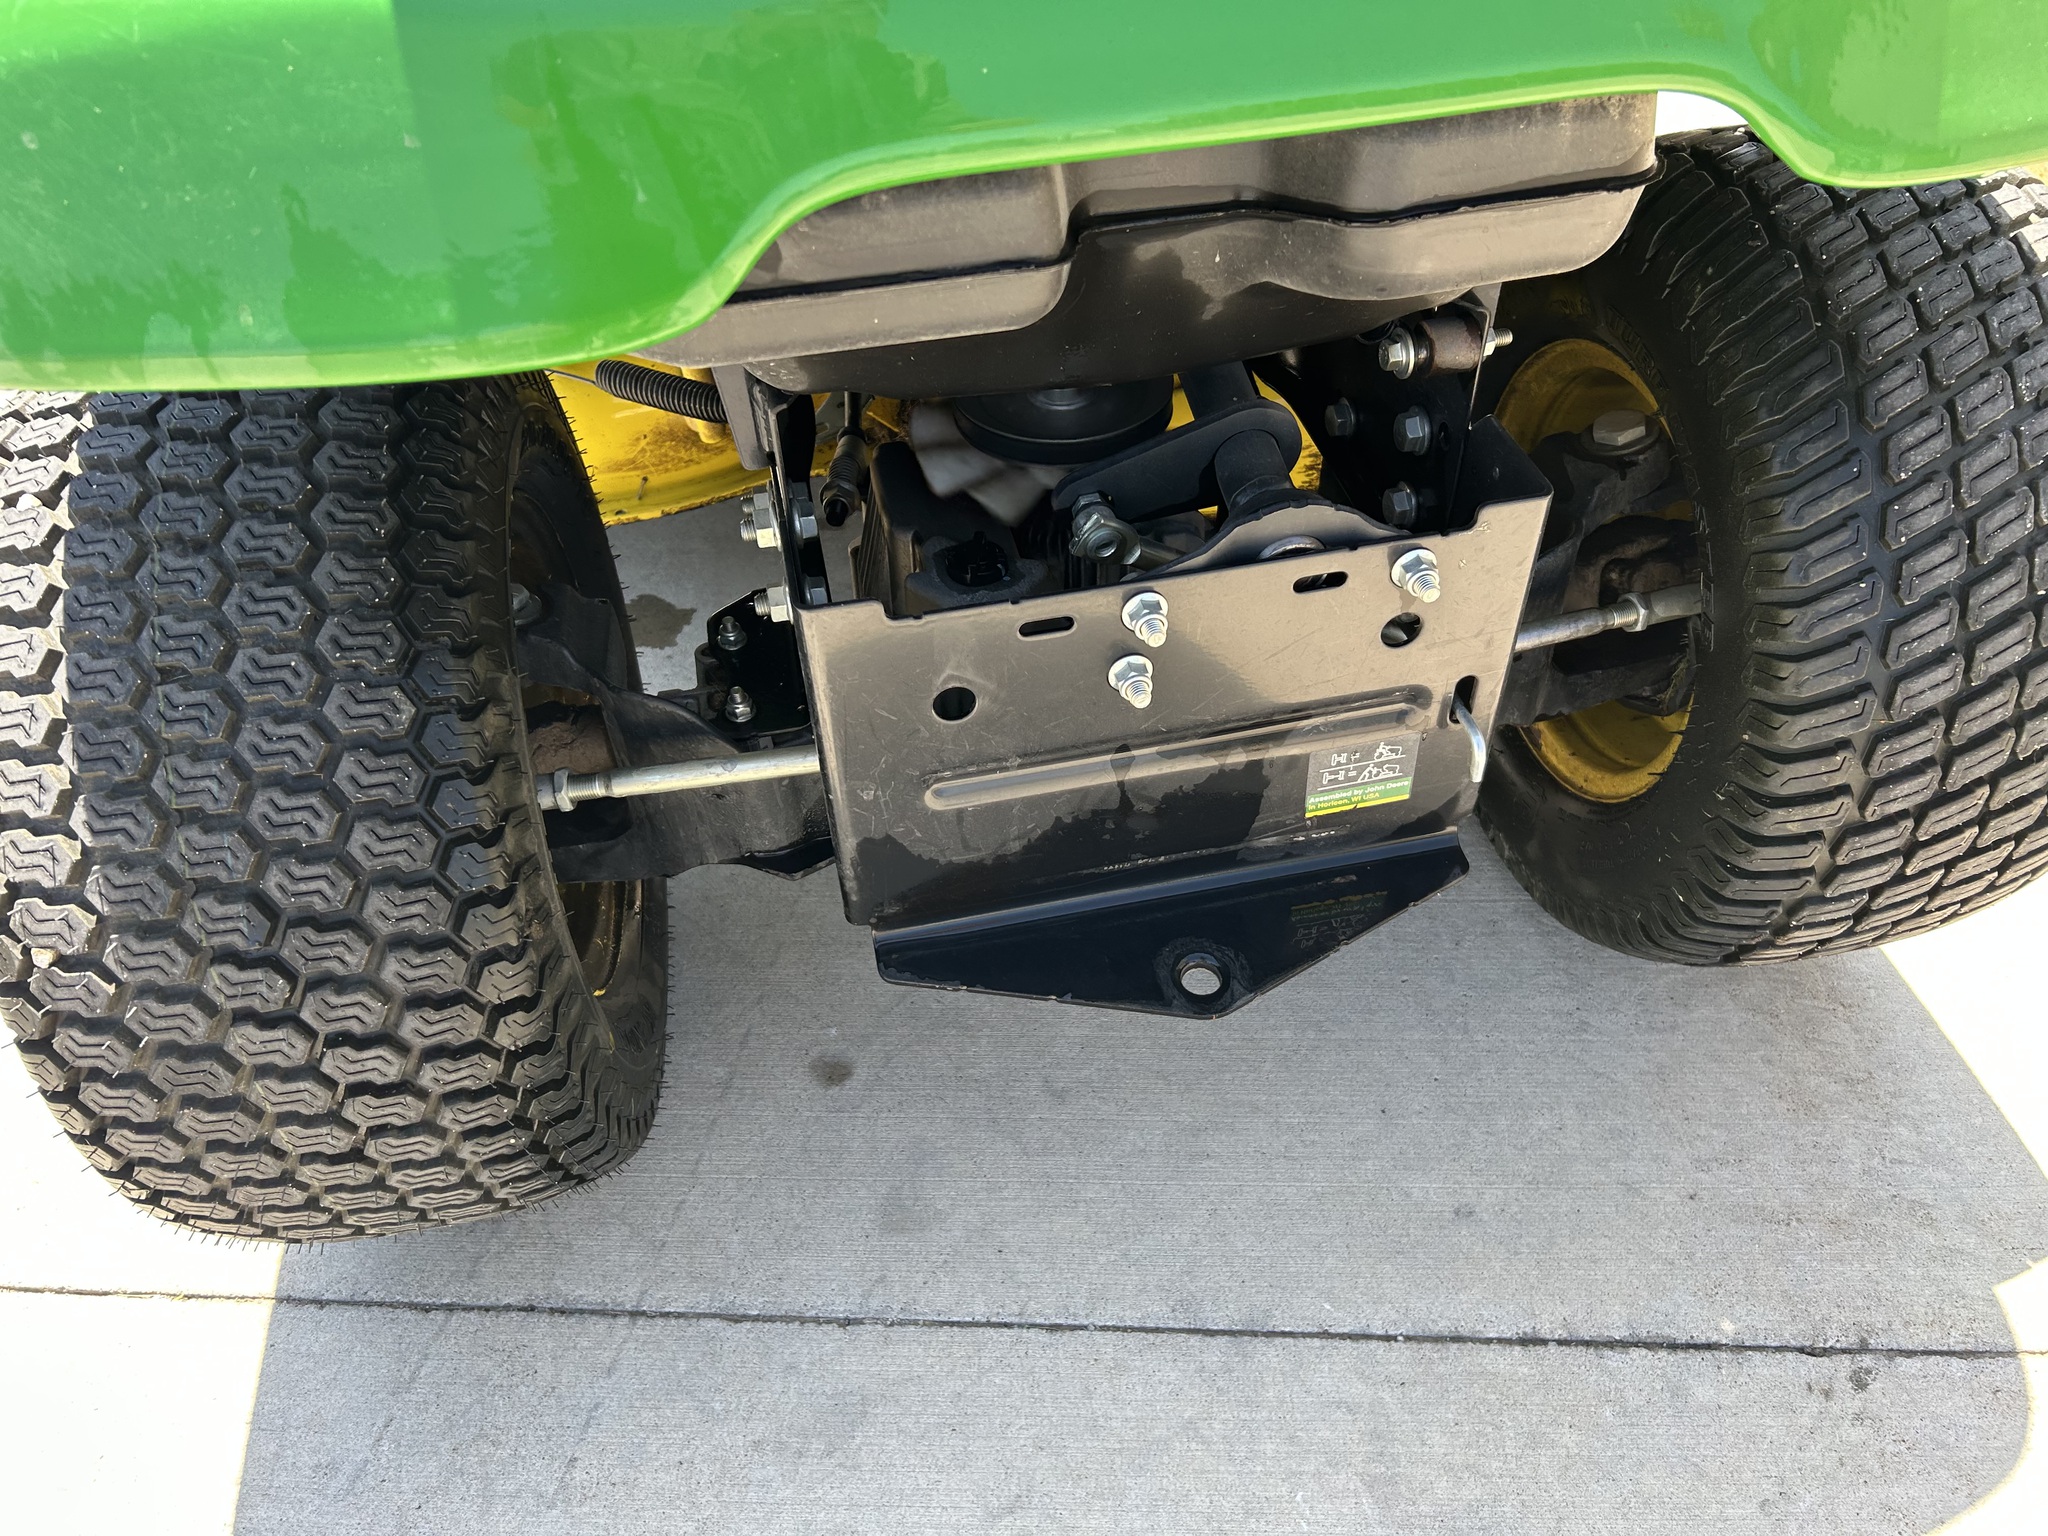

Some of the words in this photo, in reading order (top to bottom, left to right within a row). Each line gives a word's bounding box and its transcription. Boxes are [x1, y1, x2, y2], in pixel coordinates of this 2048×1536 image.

[1309, 790, 1352, 804] Assembled
[1364, 785, 1385, 793] John
[1386, 780, 1409, 789] Deere
[1362, 792, 1380, 800] USA
